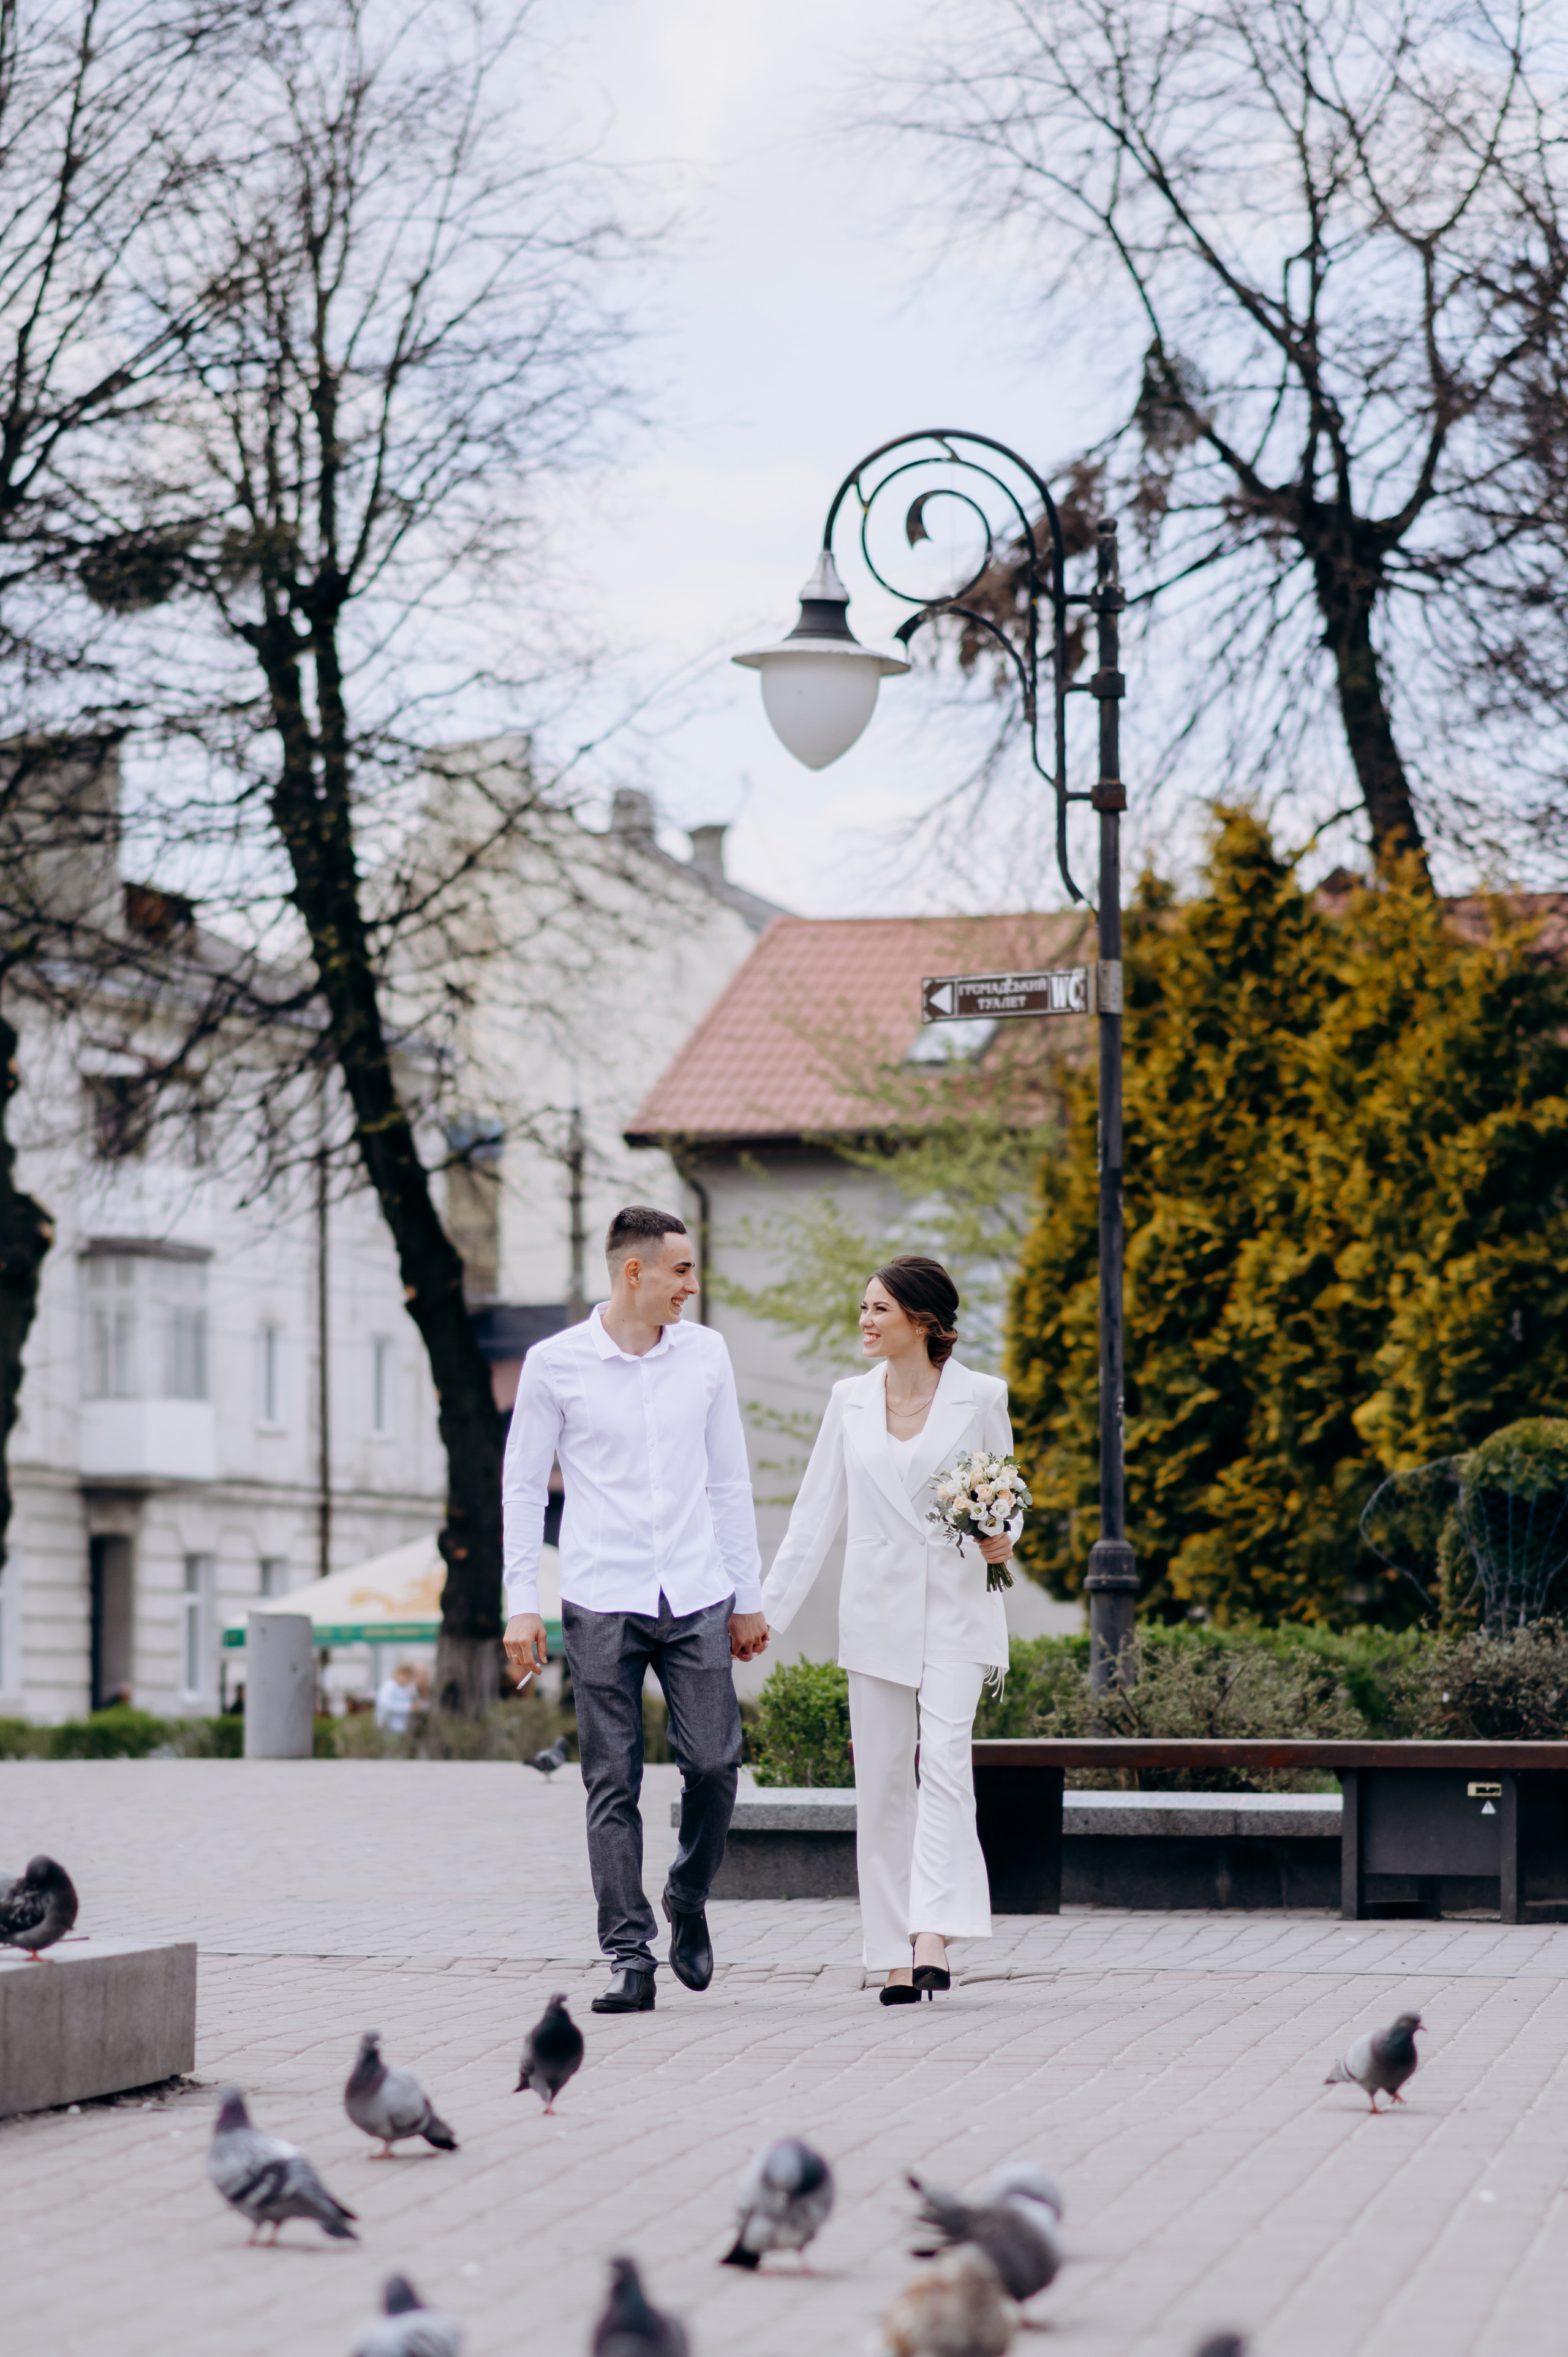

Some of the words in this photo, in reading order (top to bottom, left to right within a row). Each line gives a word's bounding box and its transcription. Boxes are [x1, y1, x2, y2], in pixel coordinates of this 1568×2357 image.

[959, 978, 1047, 996] ГРОМАДСЬКИЙ
[1051, 976, 1080, 1008] WC
[978, 996, 1027, 1009] ТУАЛЕТ
